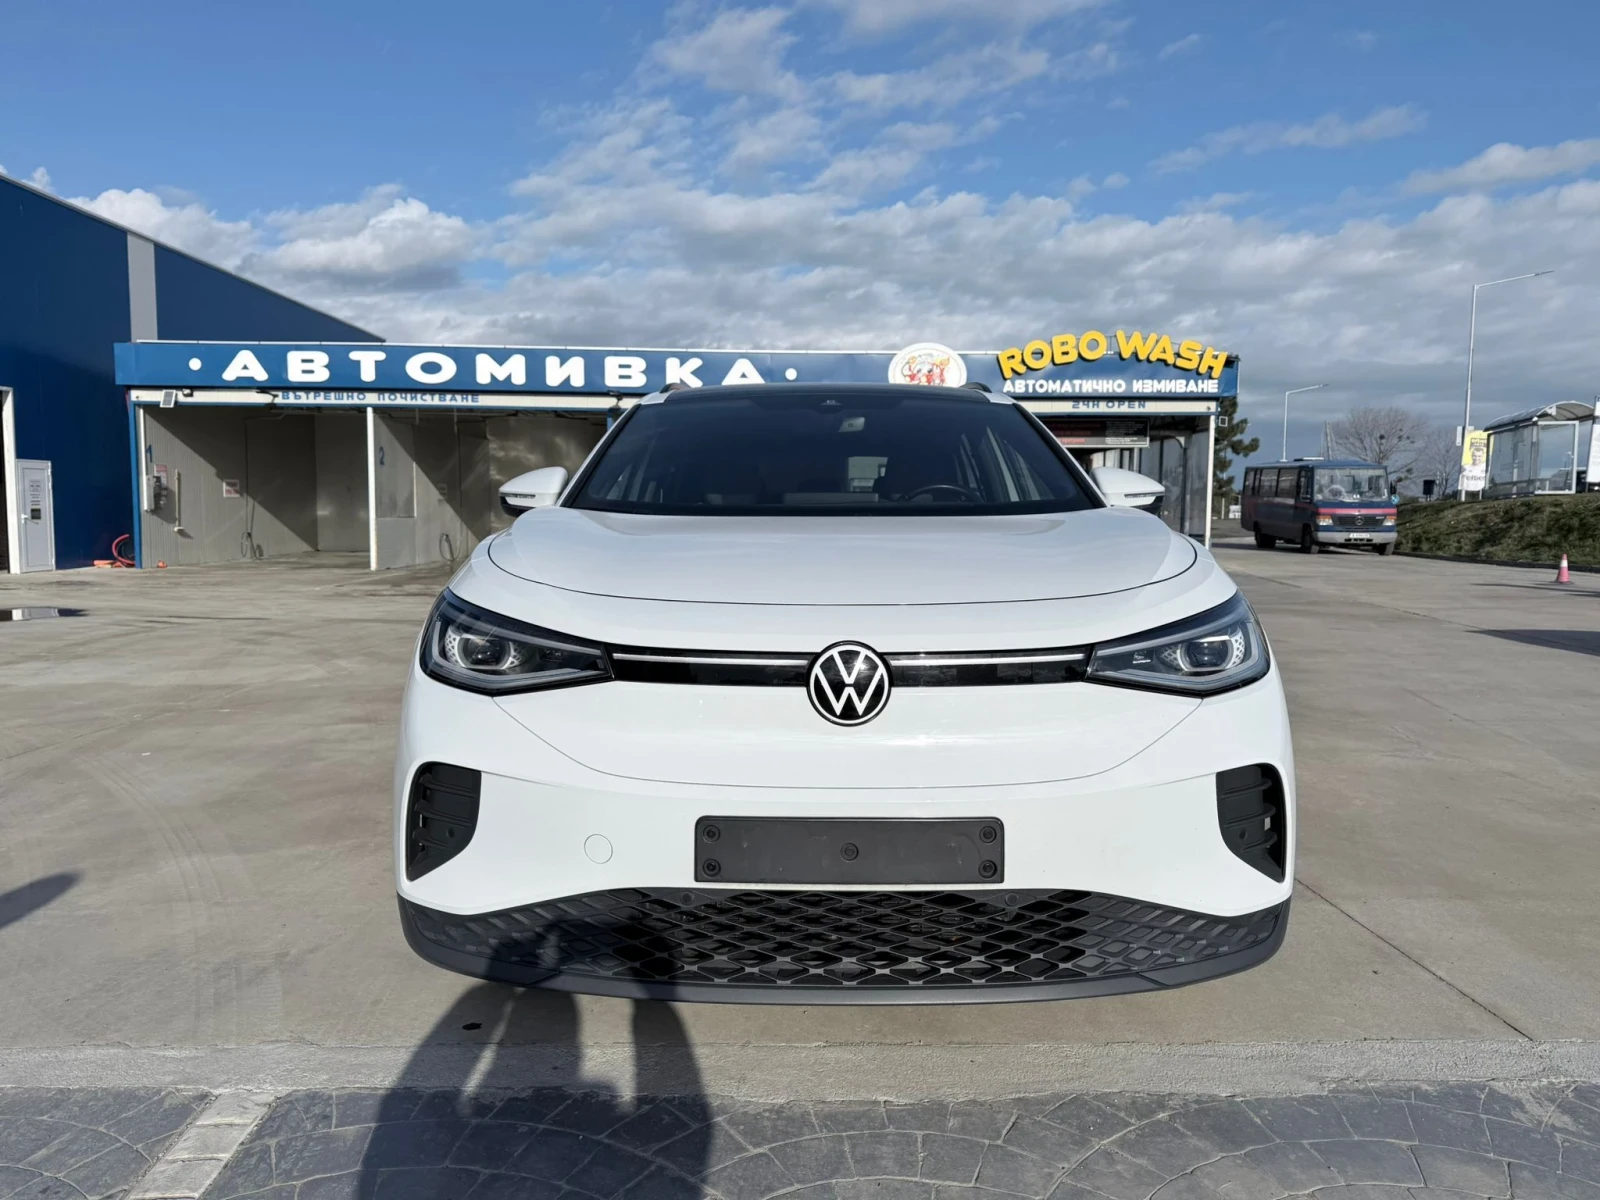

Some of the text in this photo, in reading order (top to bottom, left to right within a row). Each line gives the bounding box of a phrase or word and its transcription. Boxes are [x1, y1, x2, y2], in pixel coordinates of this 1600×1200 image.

[998, 329, 1228, 379] ROBO WASH
[221, 349, 766, 388] АВТОМИВКА
[1002, 379, 1219, 394] АВТОМАТИЧНО ИЗМИВАНЕ
[281, 391, 480, 403] ВЪТРЕШНО ПОЧИСТВАНЕ
[1105, 400, 1147, 409] OPEN
